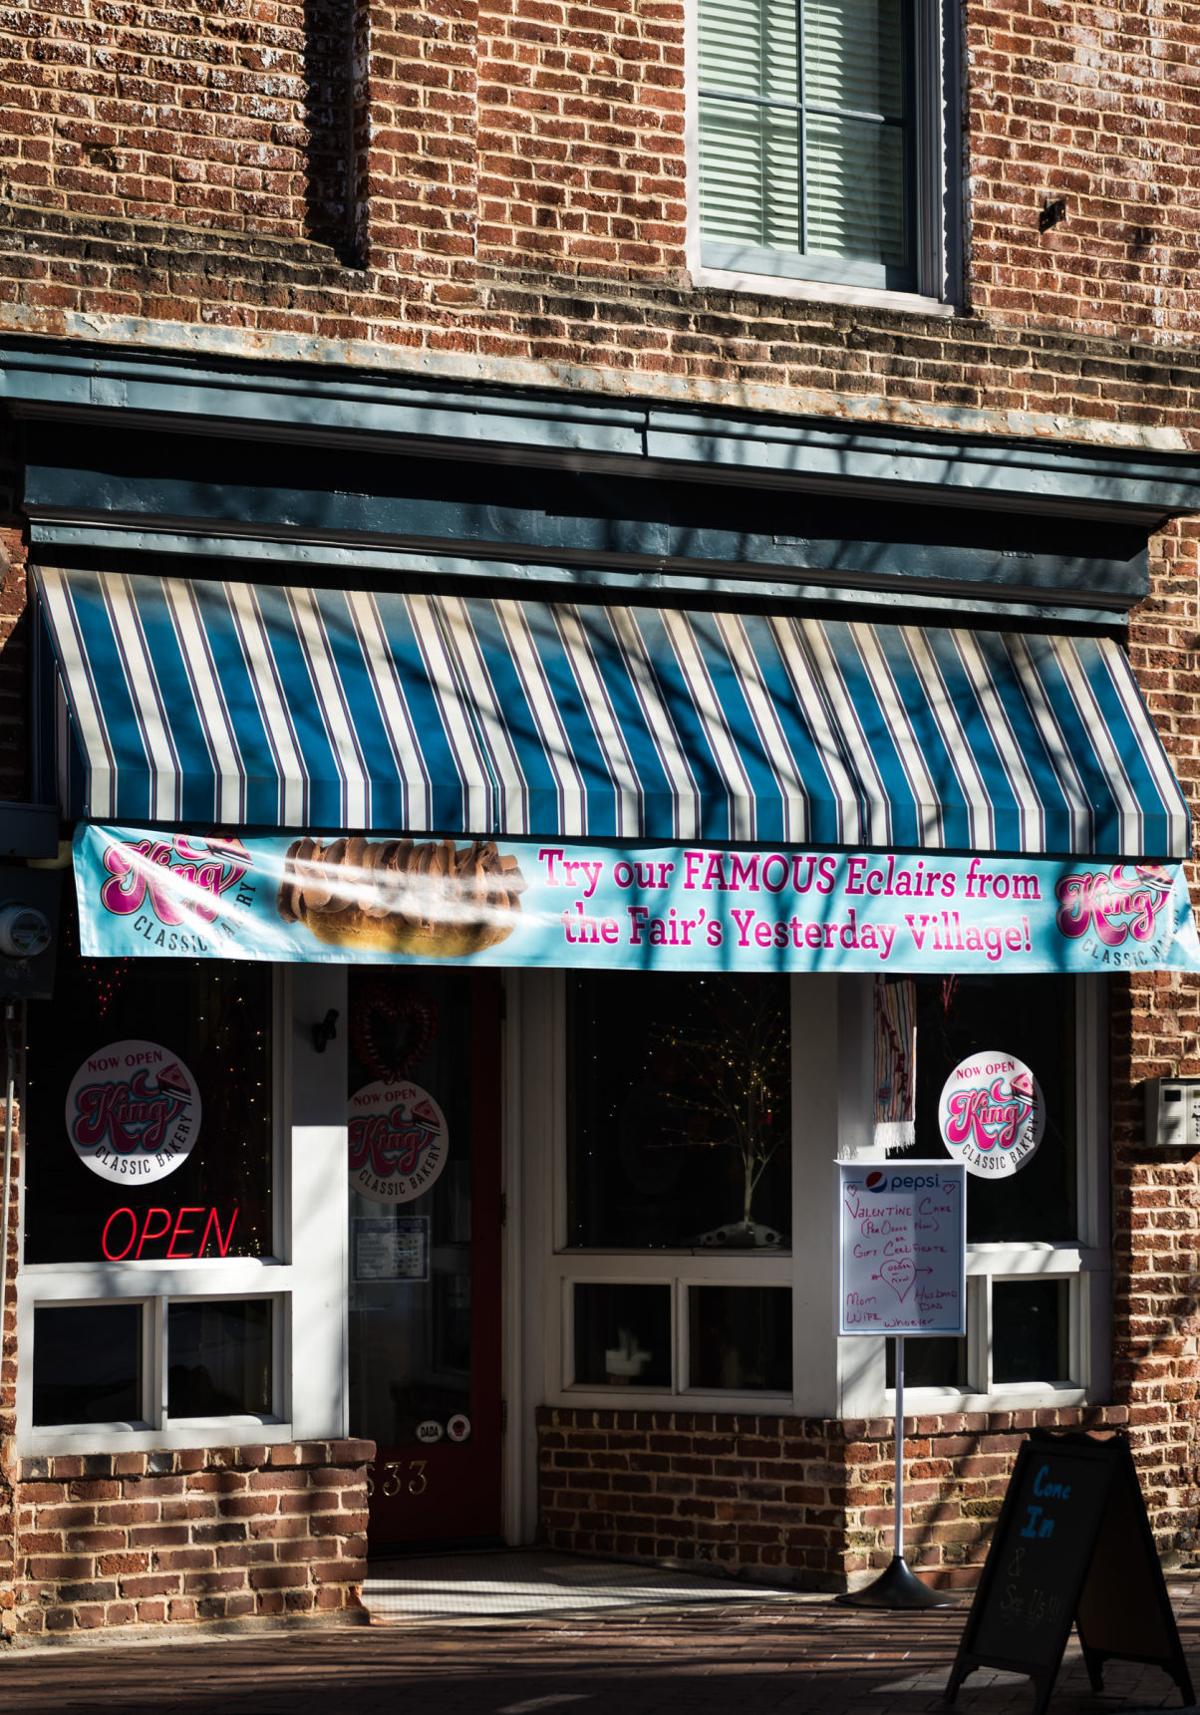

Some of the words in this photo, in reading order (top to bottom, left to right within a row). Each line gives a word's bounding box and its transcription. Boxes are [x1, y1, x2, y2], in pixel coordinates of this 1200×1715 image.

[101, 838, 248, 926] Kng
[538, 848, 603, 898] Try
[613, 861, 674, 889] our
[683, 851, 837, 894] FAMOUS
[845, 855, 956, 897] Eclairs
[965, 857, 1041, 900] from
[134, 915, 208, 953] CLASSIC
[561, 901, 620, 943] the
[627, 905, 722, 947] Fair's
[731, 908, 898, 960] Yesterday
[904, 911, 1032, 961] Village!
[1055, 872, 1170, 947] King
[1082, 939, 1148, 967] CLASSIC
[88, 1057, 120, 1073] NOW
[125, 1051, 163, 1068] OPEN
[957, 1067, 981, 1080] NOW
[985, 1061, 1016, 1076] OPEN
[73, 1082, 186, 1156] King
[353, 1095, 380, 1106] NOW
[385, 1089, 417, 1102] OPEN
[946, 1088, 1034, 1152] King
[95, 1145, 151, 1176] CLASSIC
[158, 1113, 193, 1168] BAKERY
[348, 1115, 436, 1178] King
[359, 1169, 406, 1196] CLASSIC
[410, 1144, 441, 1190] BAKERY
[962, 1143, 1007, 1171] CLASSIC
[1009, 1117, 1039, 1165] BAKERY
[890, 1173, 939, 1192] pepsi
[101, 1206, 239, 1261] OPEN
[1020, 1503, 1056, 1539] In
